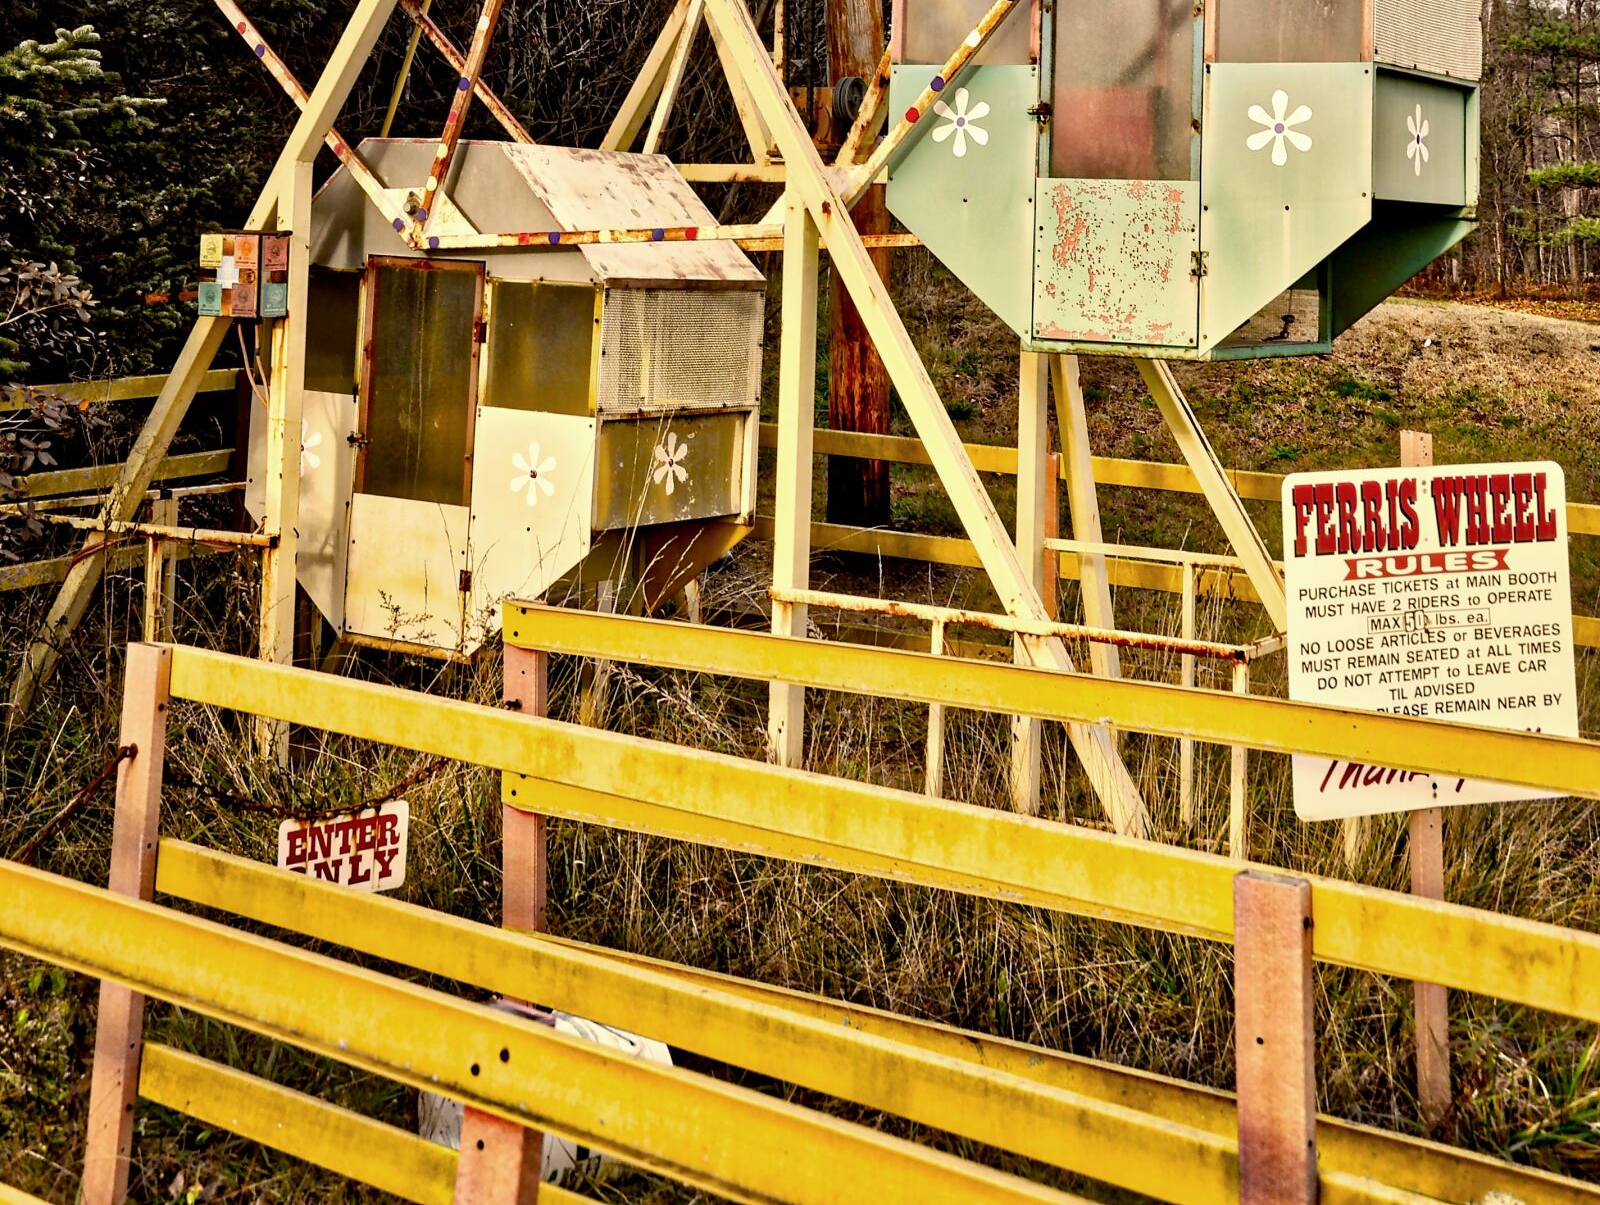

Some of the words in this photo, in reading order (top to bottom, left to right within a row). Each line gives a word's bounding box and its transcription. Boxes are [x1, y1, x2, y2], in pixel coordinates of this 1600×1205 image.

[1292, 477, 1420, 557] FERRIS
[1431, 472, 1557, 547] WHEEL
[1356, 551, 1499, 578] RULES
[1299, 584, 1376, 600] PURCHASE
[1382, 578, 1439, 595] TICKETS
[1446, 578, 1459, 590] at
[1466, 575, 1501, 588] MAIN
[1508, 572, 1557, 586] BOOTH
[1305, 604, 1345, 619] MUST
[1351, 600, 1388, 614] HAVE
[1392, 598, 1402, 611] 2
[1408, 595, 1460, 610] RIDERS
[1468, 594, 1481, 605] to
[1487, 589, 1552, 604] OPERATE
[1371, 617, 1400, 631] MAX
[1435, 613, 1460, 625] lbs.
[1467, 613, 1488, 624] ea.
[1300, 642, 1321, 655] NO
[1328, 638, 1373, 653] LOOSE
[1381, 630, 1446, 648] ARTICLES
[1453, 630, 1468, 641] or
[1474, 623, 1561, 640] BEVERAGES
[1302, 659, 1341, 674] MUST
[1348, 653, 1400, 668] REMAIN
[1406, 648, 1459, 664] SEATED
[1467, 647, 1481, 658] at
[1487, 643, 1512, 656] ALL
[1518, 640, 1561, 654] TIMES
[1318, 677, 1338, 690] DO
[1344, 673, 1372, 687] NOT
[1379, 667, 1439, 683] ATTEMPT
[1447, 666, 1460, 678] to
[1467, 662, 1512, 676] LEAVE
[1518, 659, 1547, 673] CAR
[1389, 688, 1408, 701] TIL
[1414, 682, 1475, 697] ADVISED
[1435, 699, 1490, 714] REMAIN
[1498, 696, 1536, 709] NEAR
[1543, 694, 1562, 705] BY
[286, 814, 400, 865] ENTER
[289, 849, 398, 885] NLY
